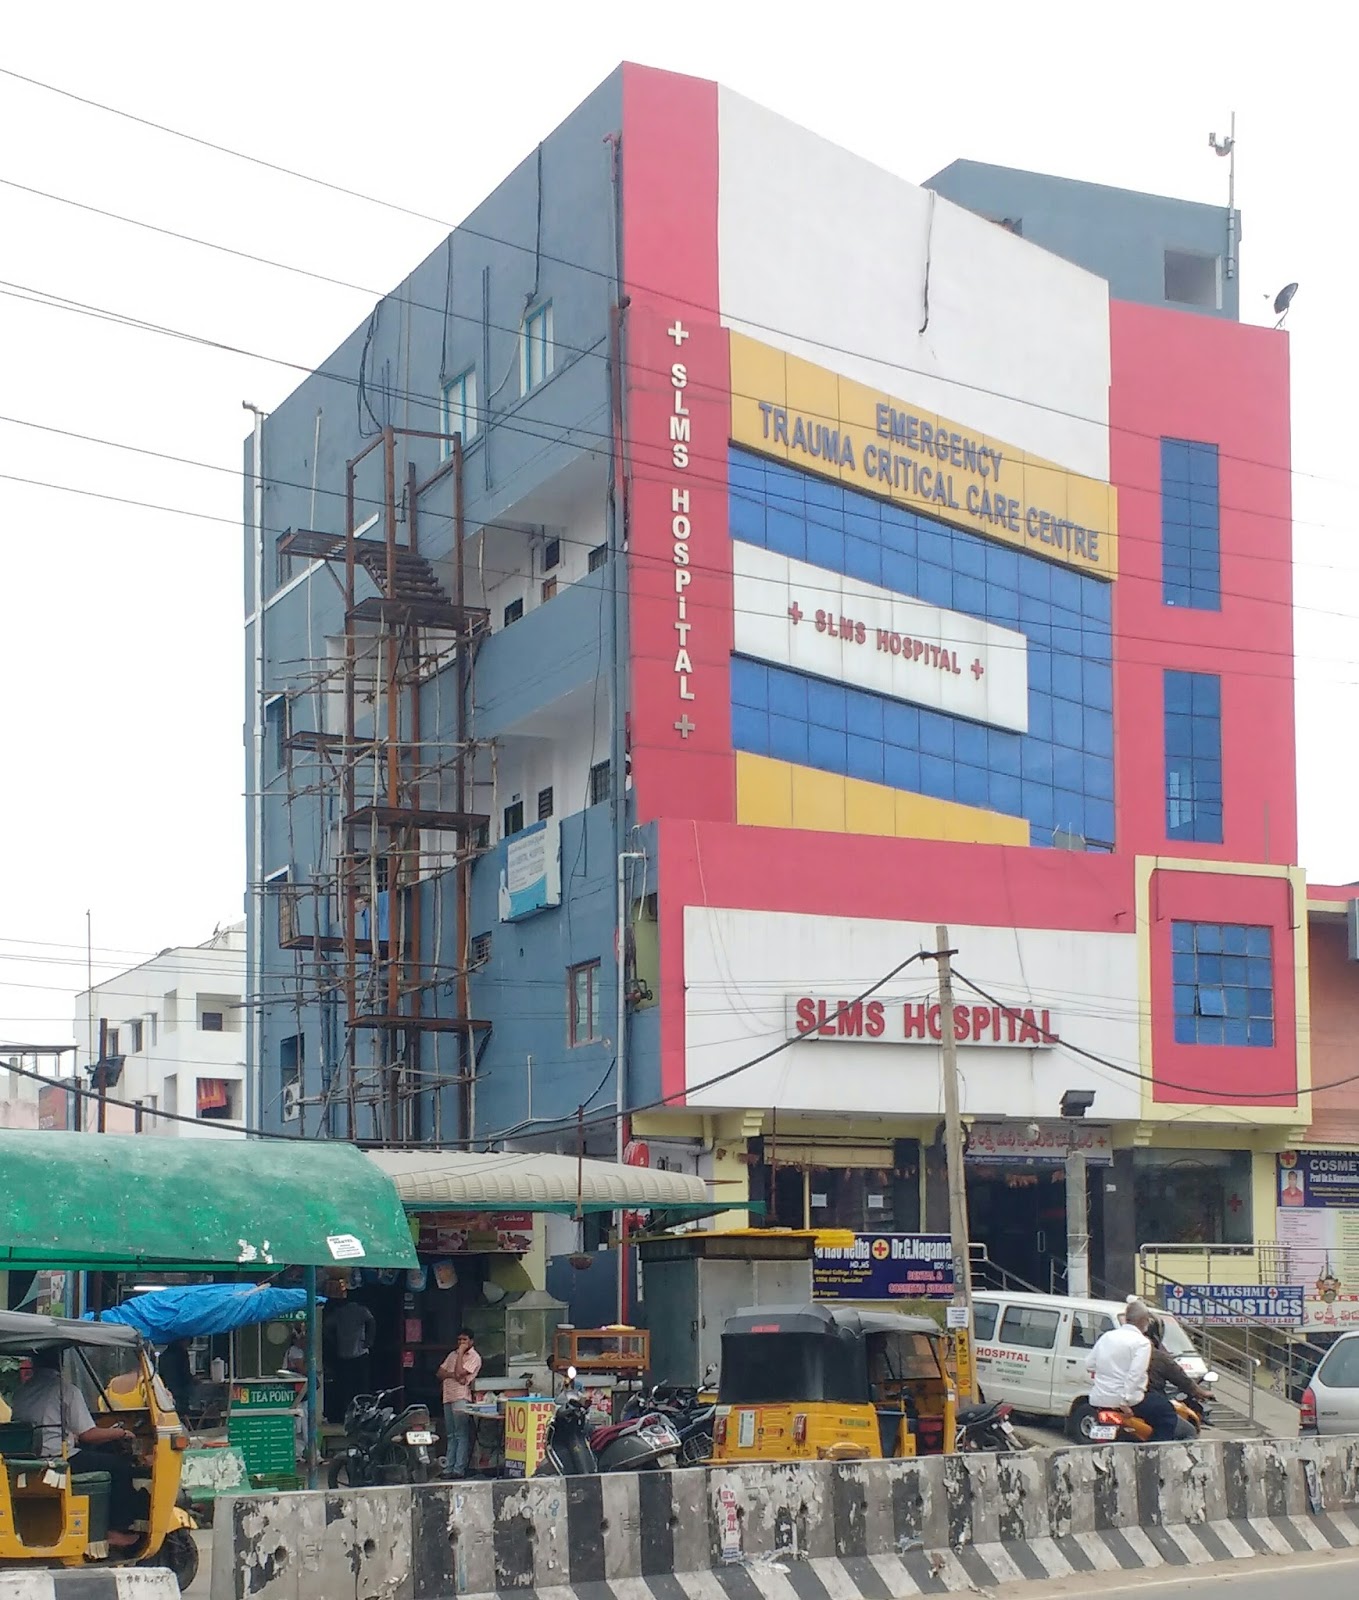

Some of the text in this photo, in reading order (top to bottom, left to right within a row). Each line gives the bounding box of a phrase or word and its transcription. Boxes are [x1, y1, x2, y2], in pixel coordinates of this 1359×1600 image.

[669, 363, 690, 468] SLMS
[876, 402, 1002, 482] EMERGENCY
[758, 402, 1099, 561] TRAUMA CRITICAL CARE CENTRE
[815, 609, 961, 675] SLMS HOSPITAL
[796, 998, 1060, 1044] SLMS HOSPITAL
[1166, 1298, 1302, 1316] DIAGNOSTICS
[1214, 1286, 1265, 1297] LAKSHMI
[976, 1347, 1030, 1362] HOSPITAL
[251, 1391, 267, 1402] TEA
[269, 1390, 295, 1402] POINT
[507, 1406, 526, 1434] NO
